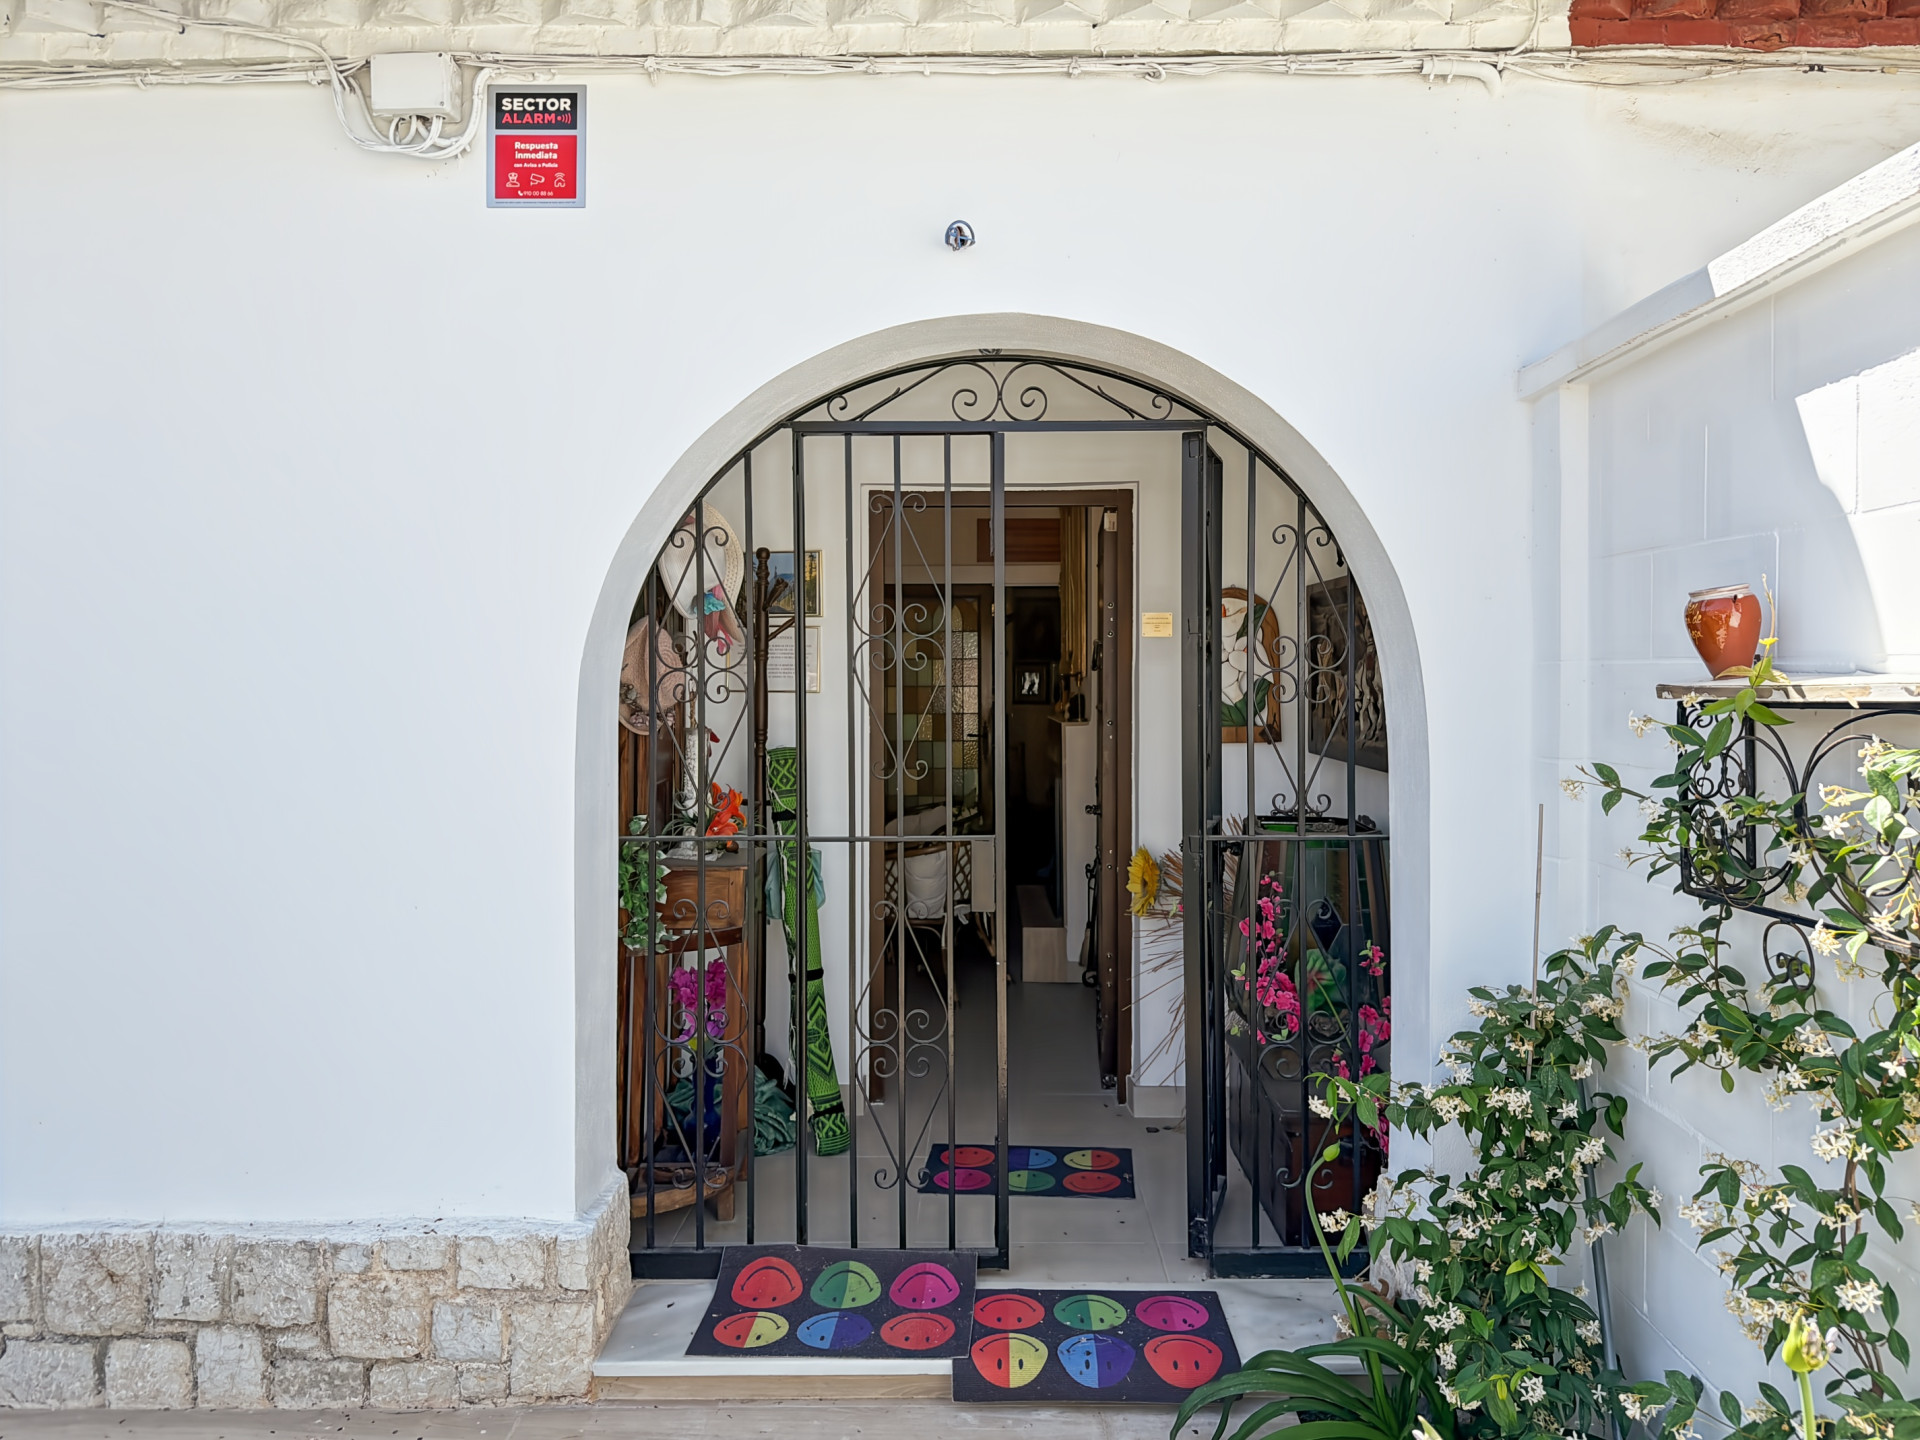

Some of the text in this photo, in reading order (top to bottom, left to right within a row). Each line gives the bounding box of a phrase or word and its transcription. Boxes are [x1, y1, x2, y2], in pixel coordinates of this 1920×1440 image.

[501, 97, 571, 111] SECTOR
[502, 113, 556, 124] ALARM
[514, 141, 558, 151] Respuesta
[515, 151, 558, 159] inmediata
